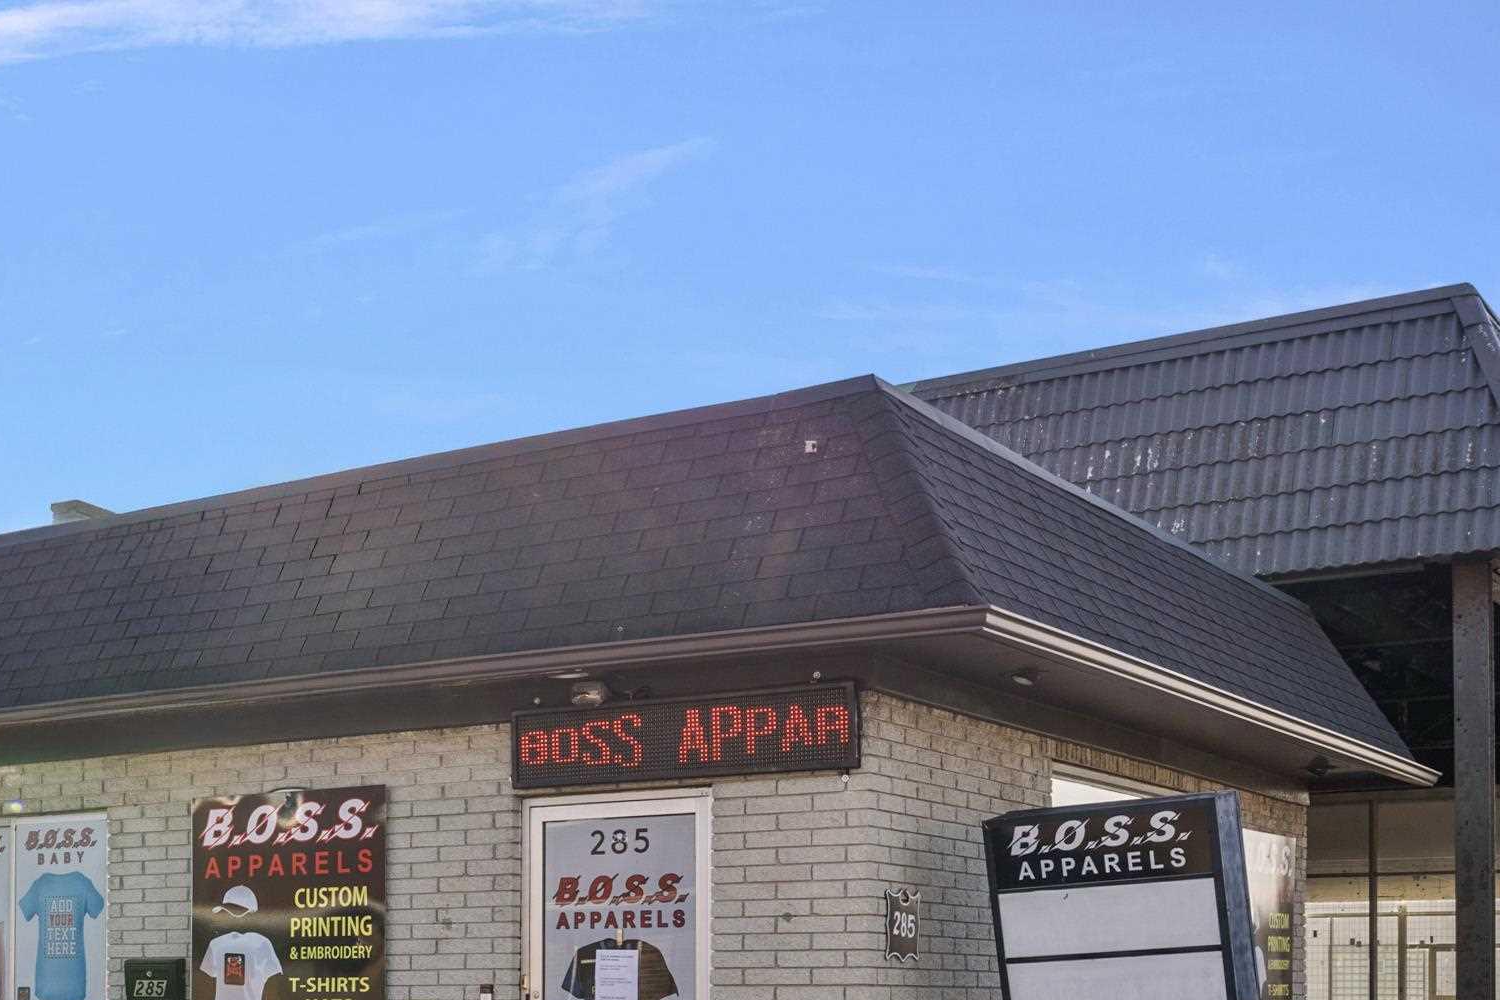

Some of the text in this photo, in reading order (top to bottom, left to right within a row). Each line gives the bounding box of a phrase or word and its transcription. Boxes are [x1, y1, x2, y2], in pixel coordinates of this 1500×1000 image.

[590, 828, 650, 855] 285
[1008, 810, 1192, 857] B.O.S.S.
[37, 851, 85, 865] BABY
[204, 849, 374, 879] APPARELS
[1018, 848, 1187, 881] APPARELS
[294, 885, 368, 908] CUSTOM
[290, 915, 373, 938] PRINTING
[556, 909, 686, 930] APPARELS
[289, 945, 373, 960] & EMBROIDERY
[135, 981, 164, 996] 285
[289, 976, 370, 993] T-SHIRTS
